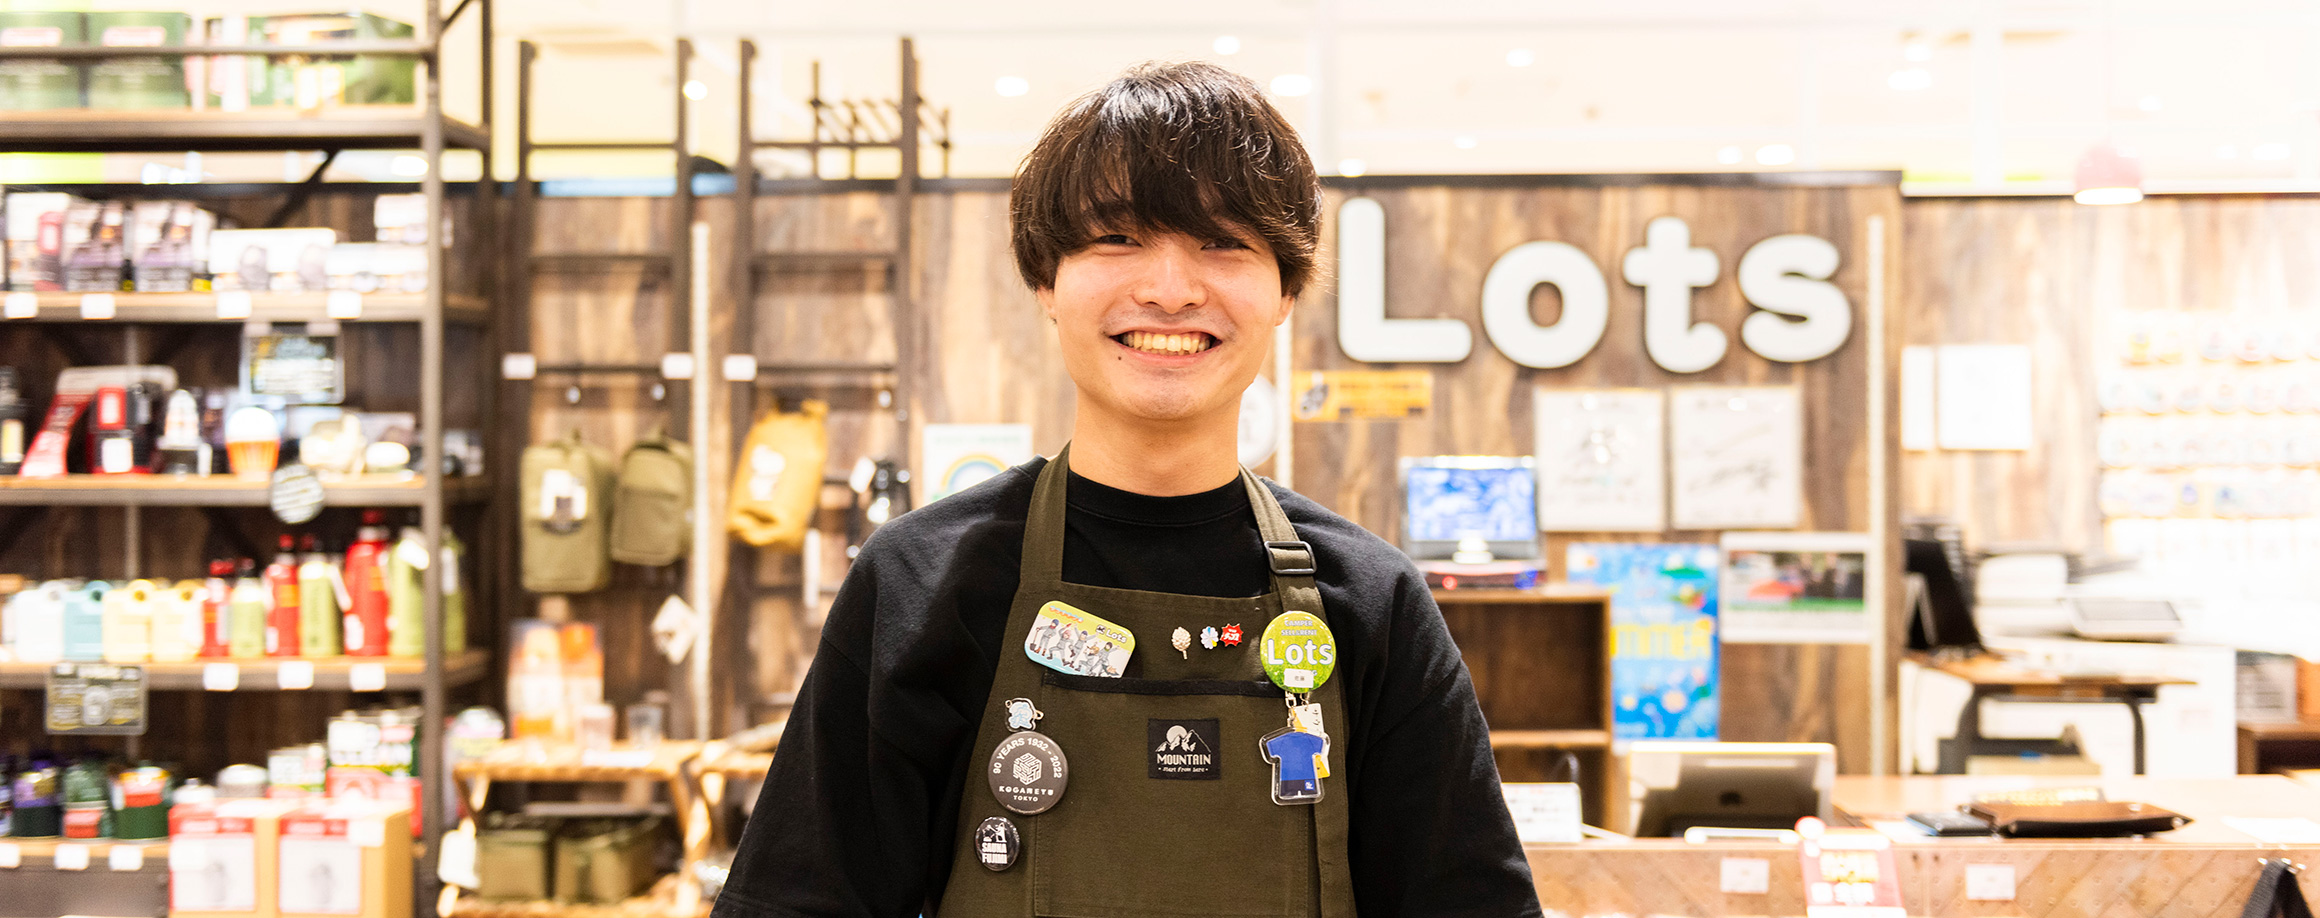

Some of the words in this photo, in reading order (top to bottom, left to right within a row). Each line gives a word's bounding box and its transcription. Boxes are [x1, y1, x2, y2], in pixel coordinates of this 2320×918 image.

[1338, 198, 1852, 374] Lots
[1106, 629, 1126, 643] Lots
[1267, 638, 1333, 665] Lots
[996, 737, 1025, 760] YEARS
[1027, 737, 1049, 752] 1932
[1050, 755, 1063, 778] 2022
[1157, 753, 1211, 765] MOUNTAIN
[993, 762, 1002, 774] 90
[982, 842, 1007, 853] SAUNA
